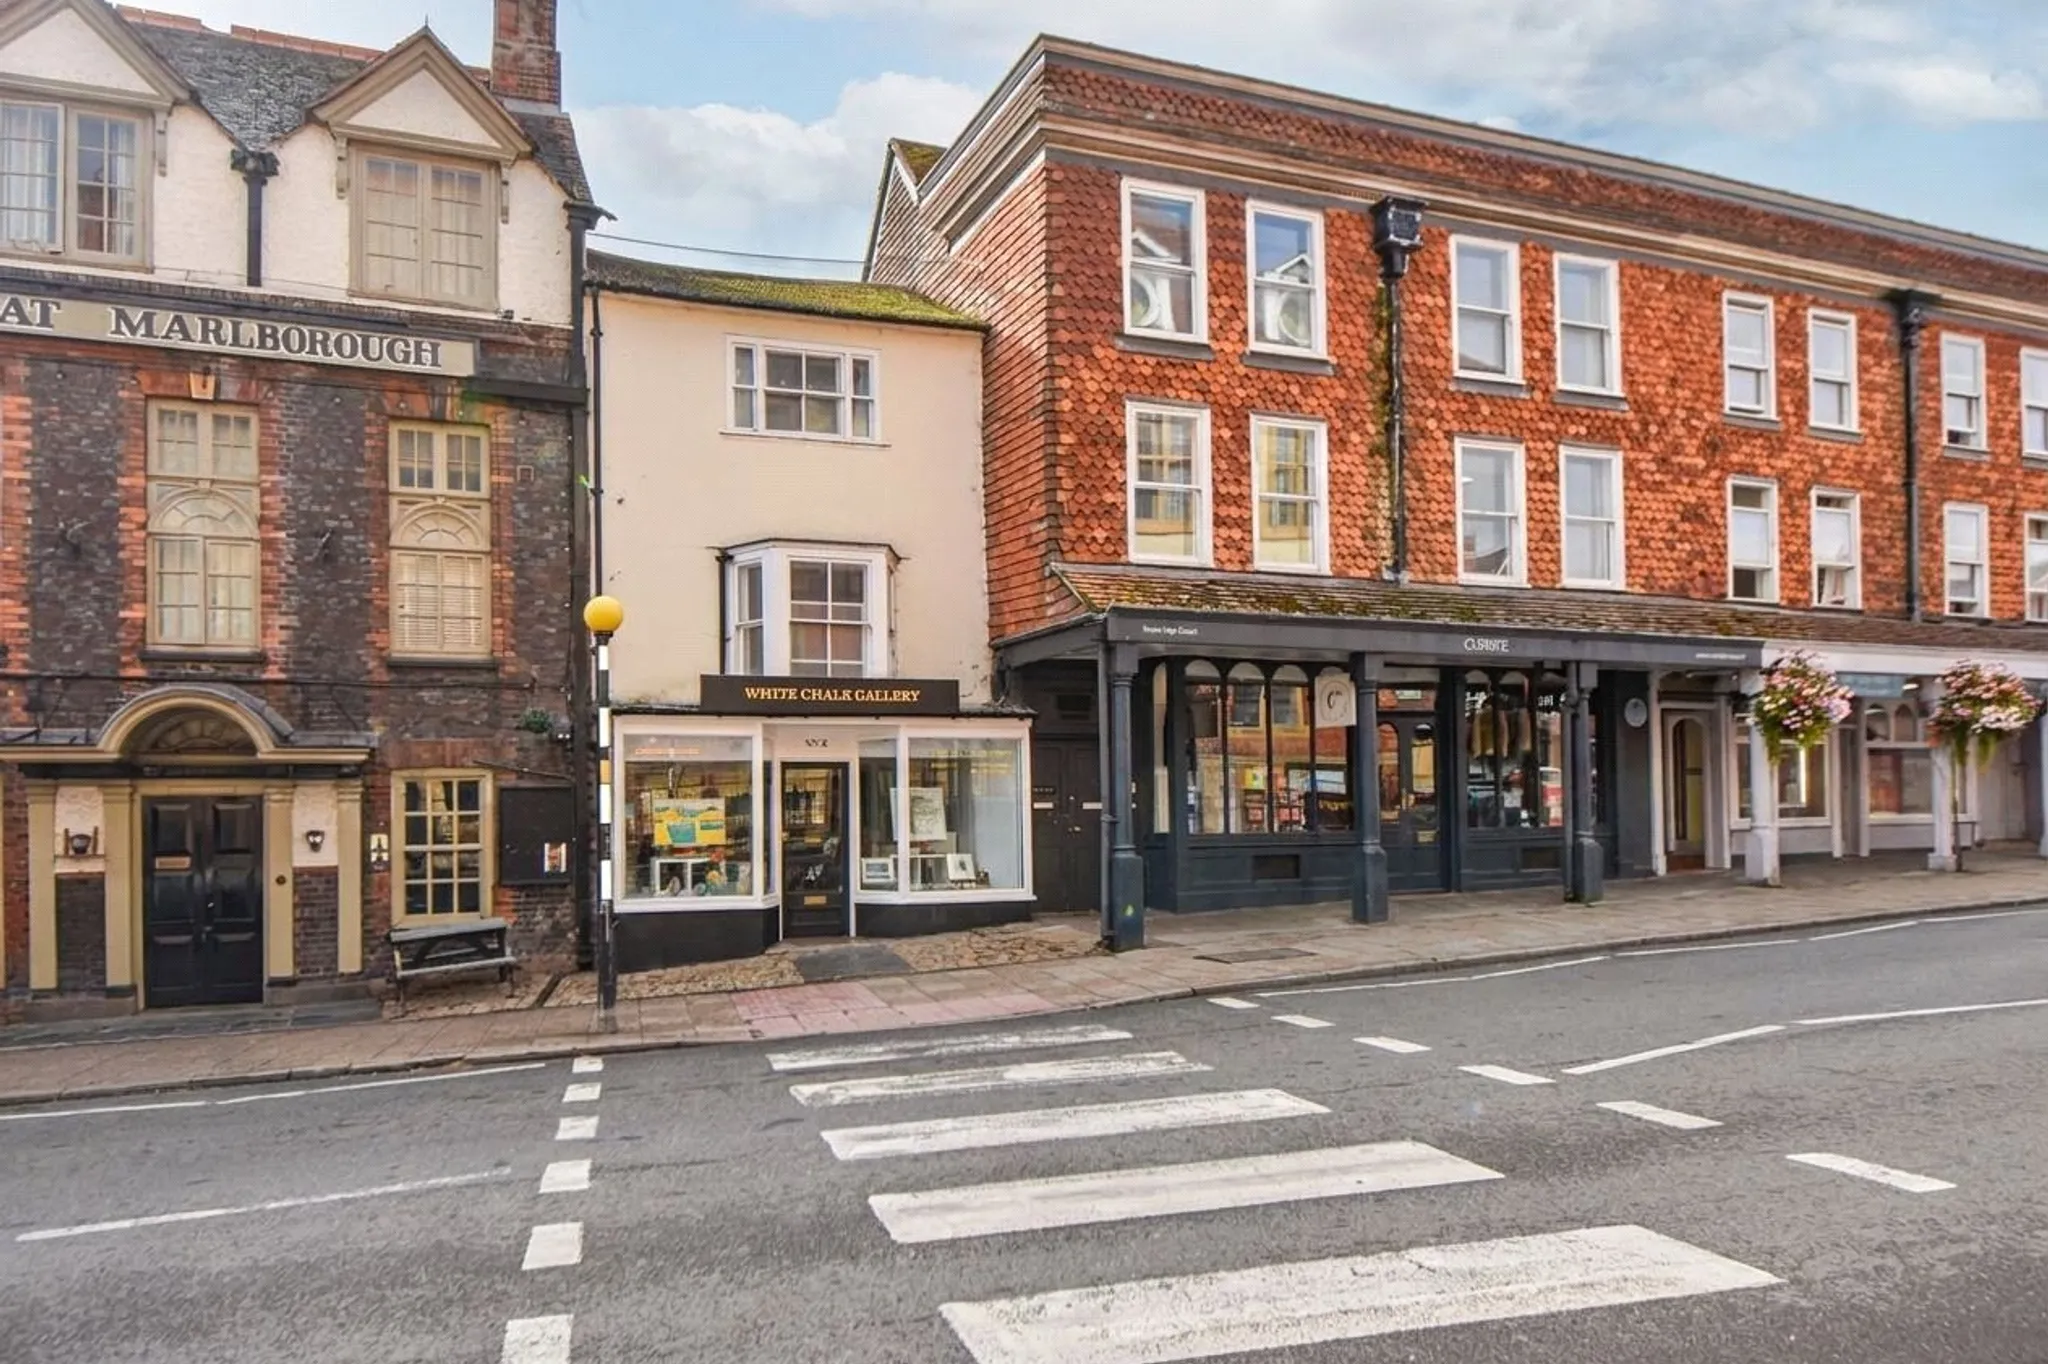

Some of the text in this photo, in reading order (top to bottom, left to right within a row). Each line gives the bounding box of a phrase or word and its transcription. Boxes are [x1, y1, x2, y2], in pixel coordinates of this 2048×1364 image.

[0, 296, 443, 368] AT MARLBOROUGH
[745, 687, 921, 702] WHITE CHALK GALLERY
